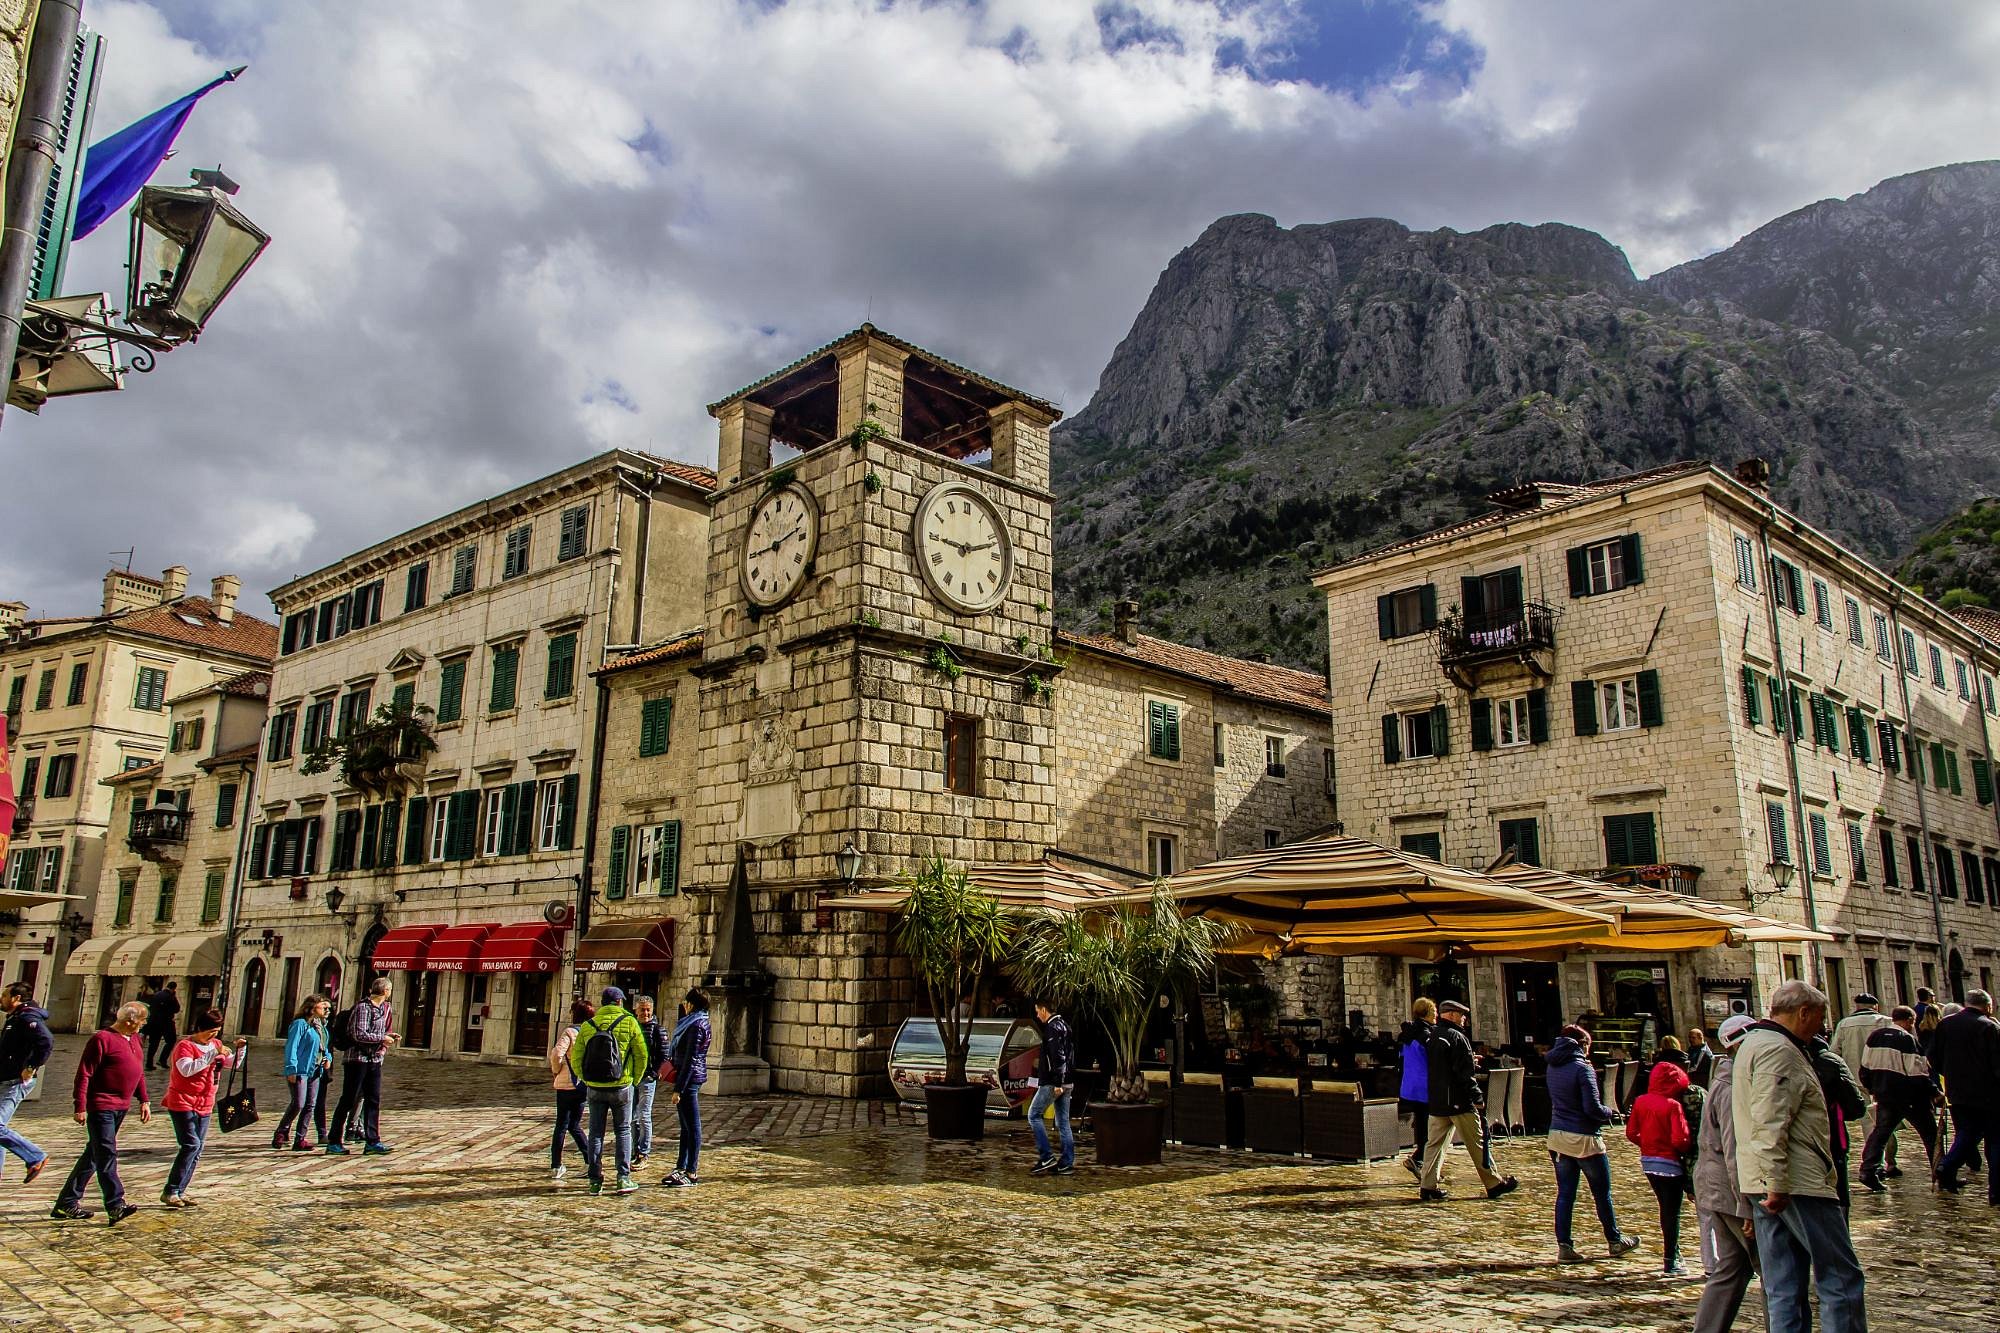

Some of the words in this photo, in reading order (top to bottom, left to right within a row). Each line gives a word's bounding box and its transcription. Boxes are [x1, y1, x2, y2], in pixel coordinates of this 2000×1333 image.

[438, 962, 455, 970] BANKA
[454, 962, 463, 970] CG
[495, 962, 513, 970] BANKA
[513, 961, 522, 970] CG
[591, 960, 618, 971] ŠTAMPA
[1003, 1079, 1030, 1090] PreGe
